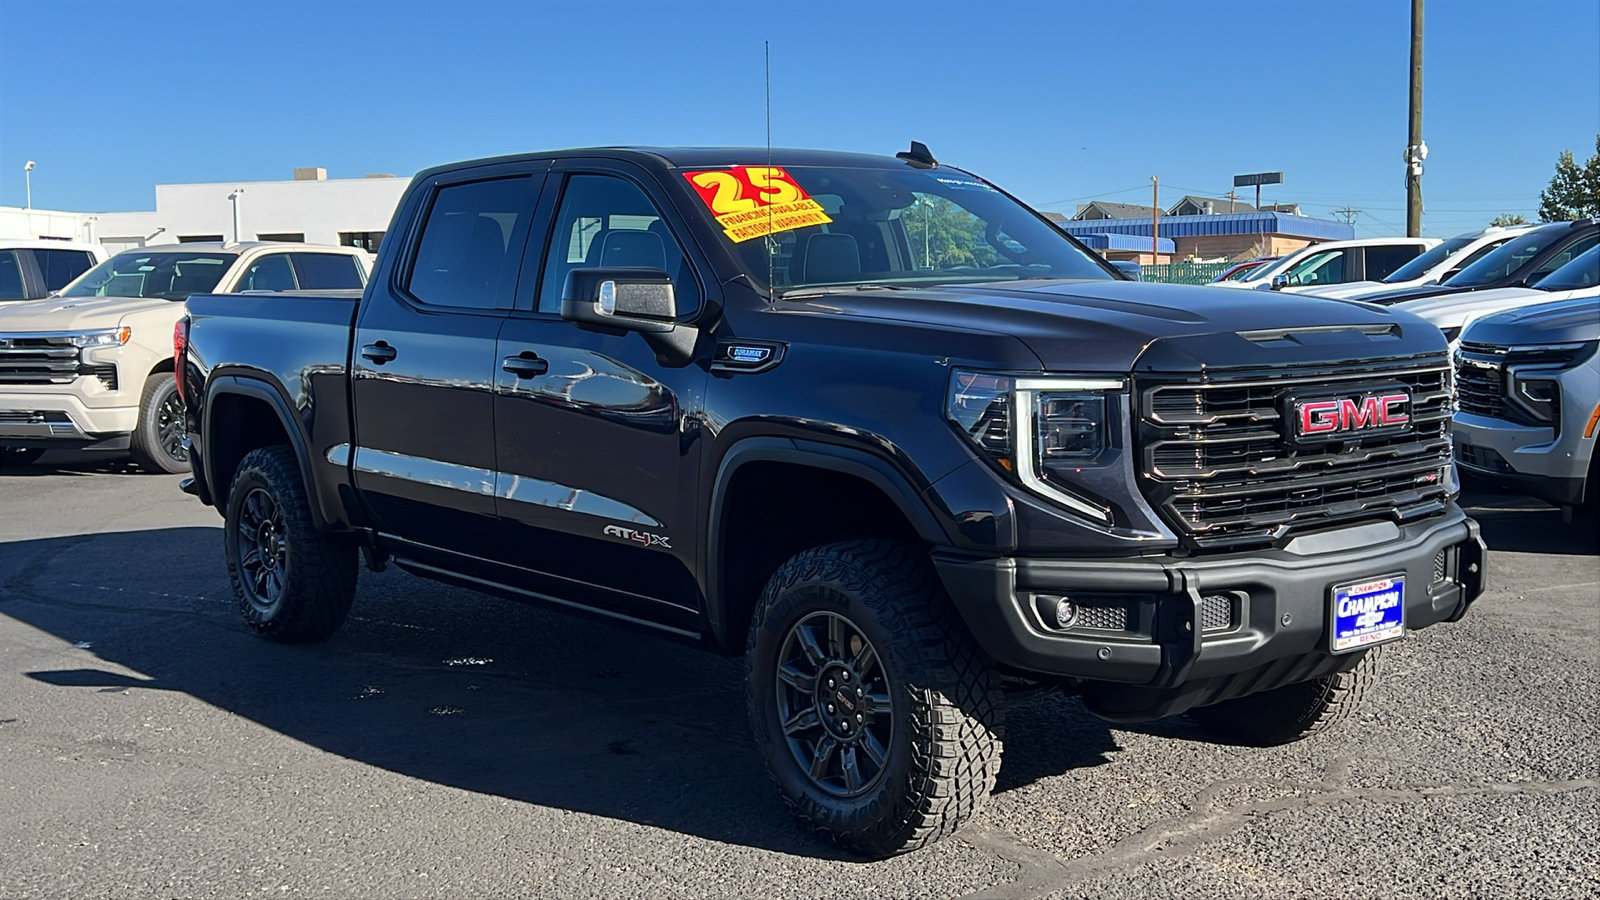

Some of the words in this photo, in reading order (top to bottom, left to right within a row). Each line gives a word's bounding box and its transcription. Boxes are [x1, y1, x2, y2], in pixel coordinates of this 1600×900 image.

[693, 168, 802, 214] 25
[721, 207, 770, 227] FINANCING
[771, 201, 818, 216] AVAILABLE
[732, 221, 771, 239] FACTORY
[776, 213, 825, 229] WARRANTY
[734, 349, 763, 357] DURAMAX
[1301, 393, 1410, 435] GMC
[603, 524, 672, 549] AT4X
[1354, 582, 1388, 594] CHAMPION
[1338, 591, 1399, 618] CHAMPION
[1359, 633, 1382, 643] RENO
